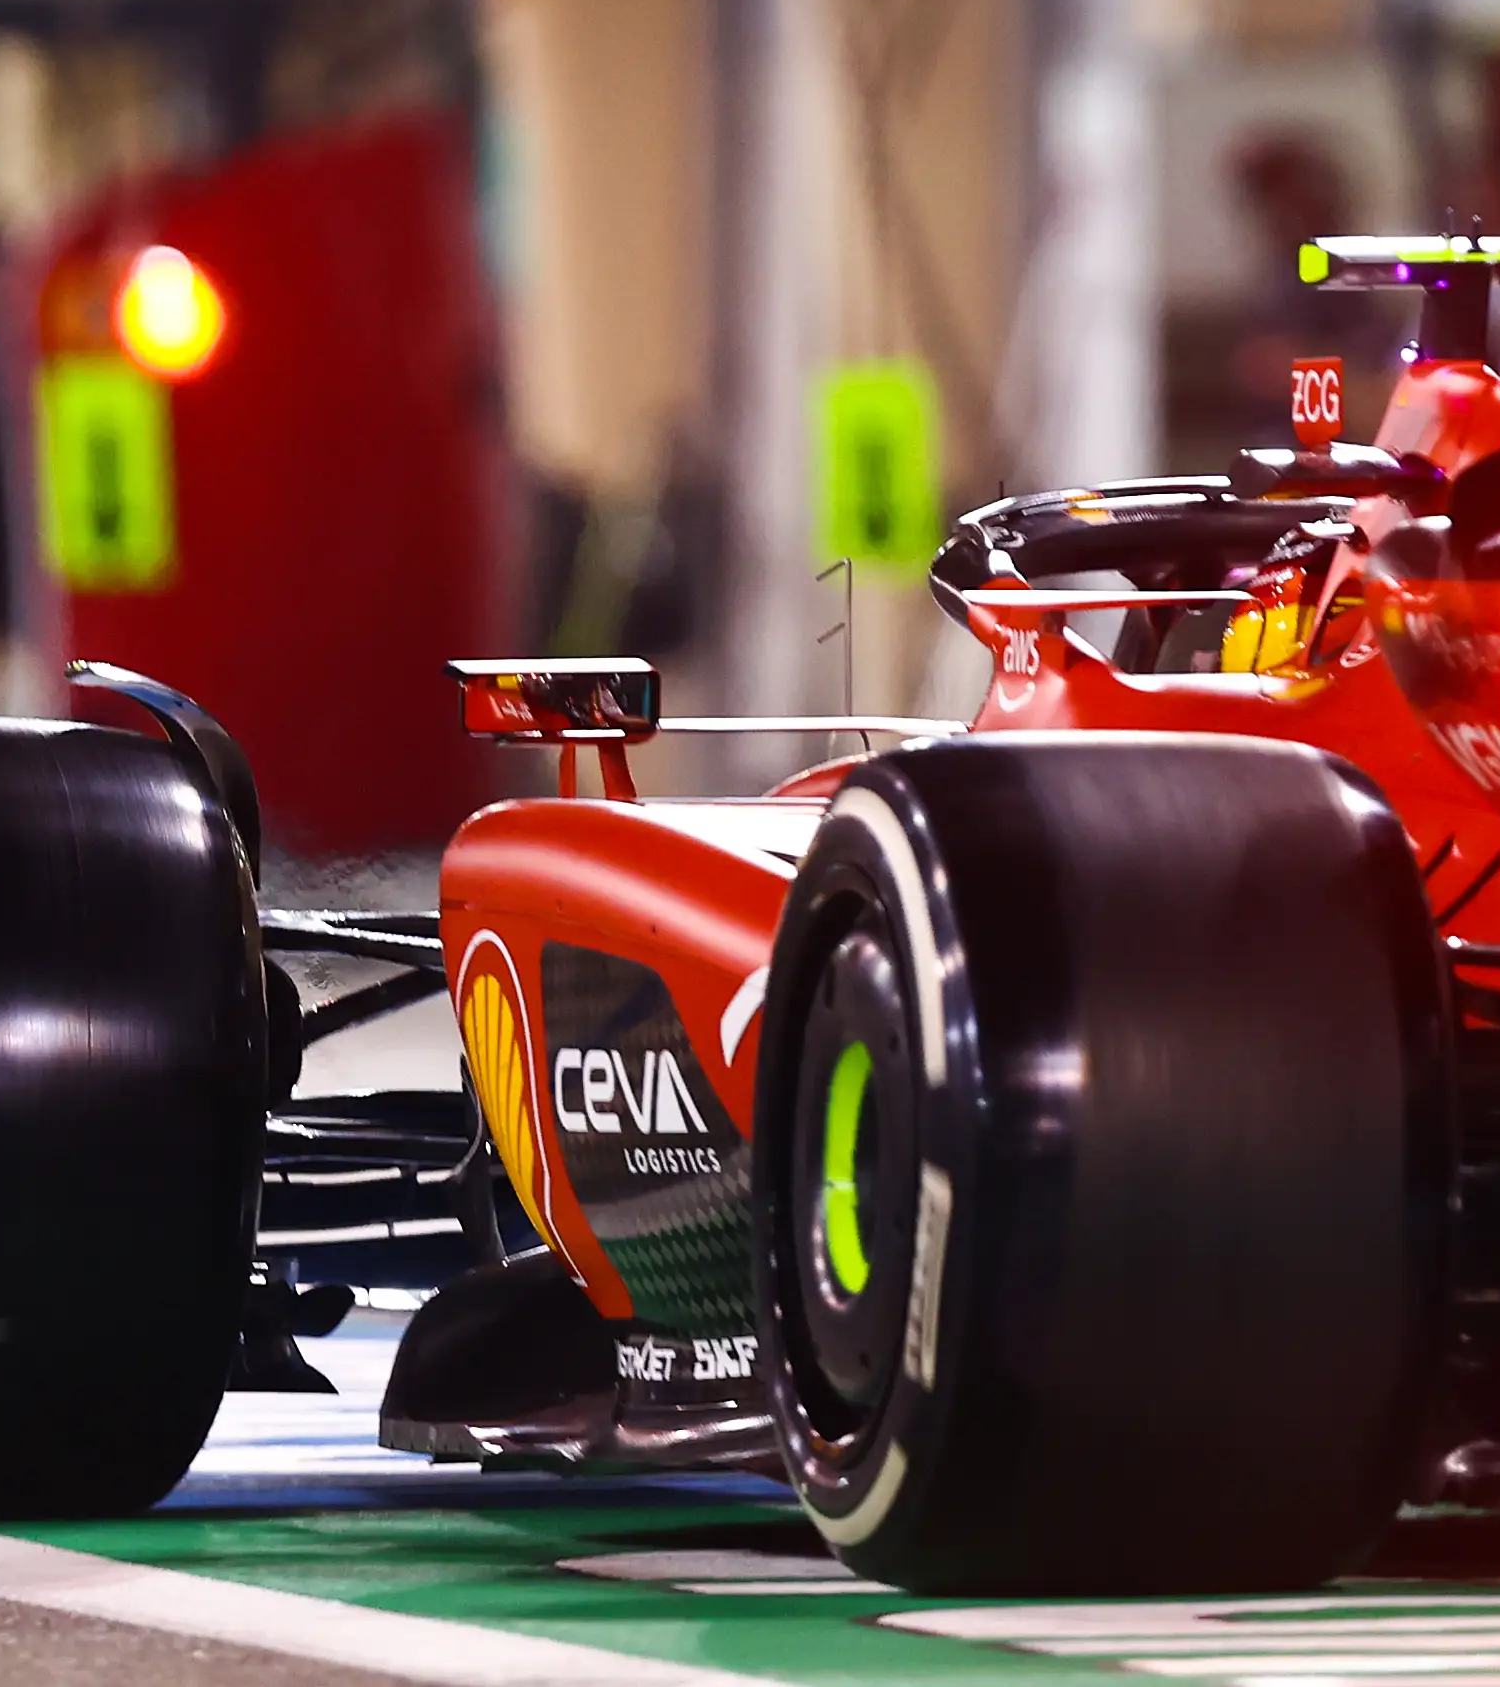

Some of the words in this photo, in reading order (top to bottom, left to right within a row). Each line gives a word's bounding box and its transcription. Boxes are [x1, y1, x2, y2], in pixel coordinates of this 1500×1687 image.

[1291, 367, 1341, 423] ZCG
[623, 1147, 722, 1175] LOGISTICS
[692, 1335, 760, 1381] SKF
